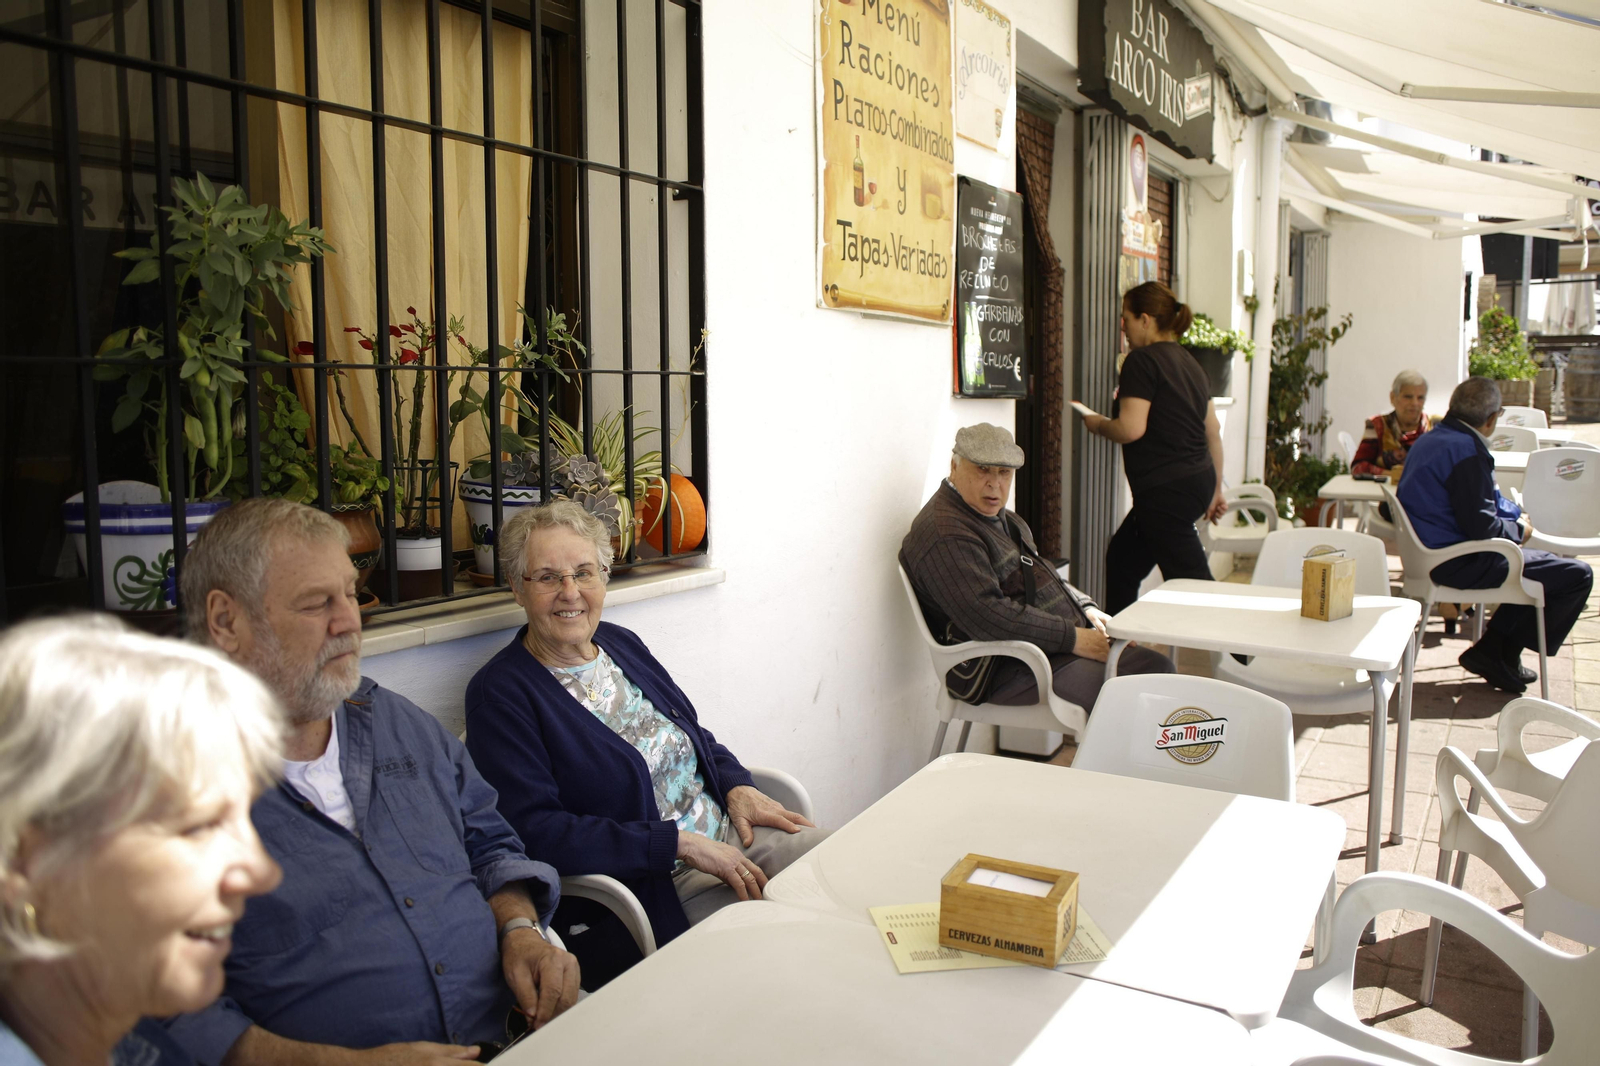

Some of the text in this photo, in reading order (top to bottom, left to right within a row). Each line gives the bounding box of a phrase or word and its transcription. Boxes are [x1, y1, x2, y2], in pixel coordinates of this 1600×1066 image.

[1130, 0, 1170, 64] BAR
[839, 19, 940, 108] Raciones
[1111, 32, 1184, 128] ARCO IRIS
[896, 166, 907, 215] y
[979, 256, 995, 273] DE
[989, 328, 1010, 342] CON
[983, 352, 1014, 370] CALLOS
[1157, 724, 1224, 746] San Miguel
[948, 928, 991, 947] CERVEZAS
[994, 938, 1044, 958] ALHAMBRA
